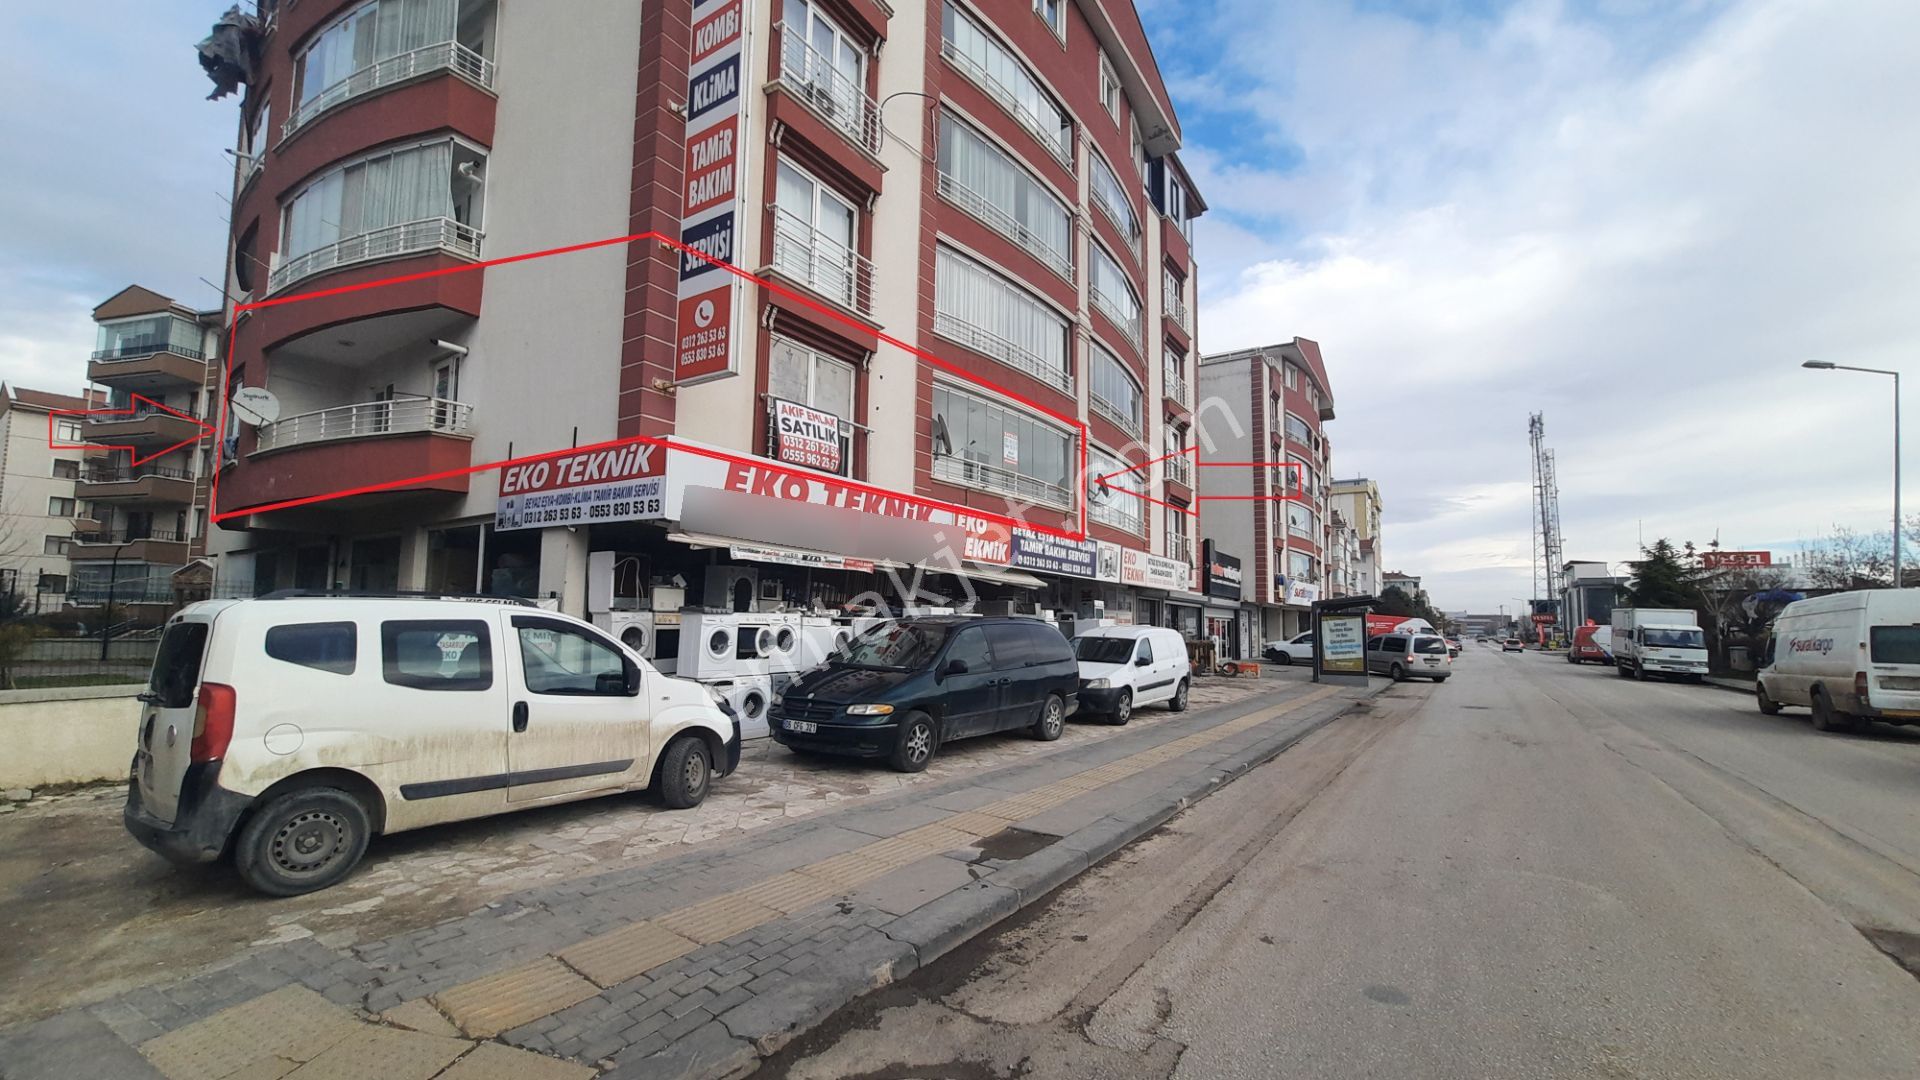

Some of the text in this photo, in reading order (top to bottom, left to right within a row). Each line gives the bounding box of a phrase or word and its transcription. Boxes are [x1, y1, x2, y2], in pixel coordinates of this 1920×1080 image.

[688, 163, 733, 209] BAKIM
[681, 326, 726, 350] 0312 263 53 63
[681, 343, 725, 366] 0553 830 53 63
[781, 417, 837, 445] SATILIK
[806, 411, 836, 428] EMLAK
[782, 449, 805, 463] 0555
[806, 453, 820, 466] 962
[783, 436, 839, 458] 0312 261 22 55
[503, 461, 549, 493] EKO
[725, 462, 810, 502] EKO
[524, 496, 543, 509] BEYAZ
[612, 485, 633, 500] BAKIM
[524, 512, 542, 524] 0312
[544, 510, 558, 522] 263
[560, 508, 569, 520] 53
[571, 507, 582, 519] 63
[589, 505, 611, 518] 0553
[613, 502, 630, 516] 830
[633, 501, 645, 514] 53
[648, 499, 660, 513] 63
[957, 514, 988, 535] EKO
[1044, 544, 1068, 559] BAKIM
[1124, 550, 1137, 565] EKO
